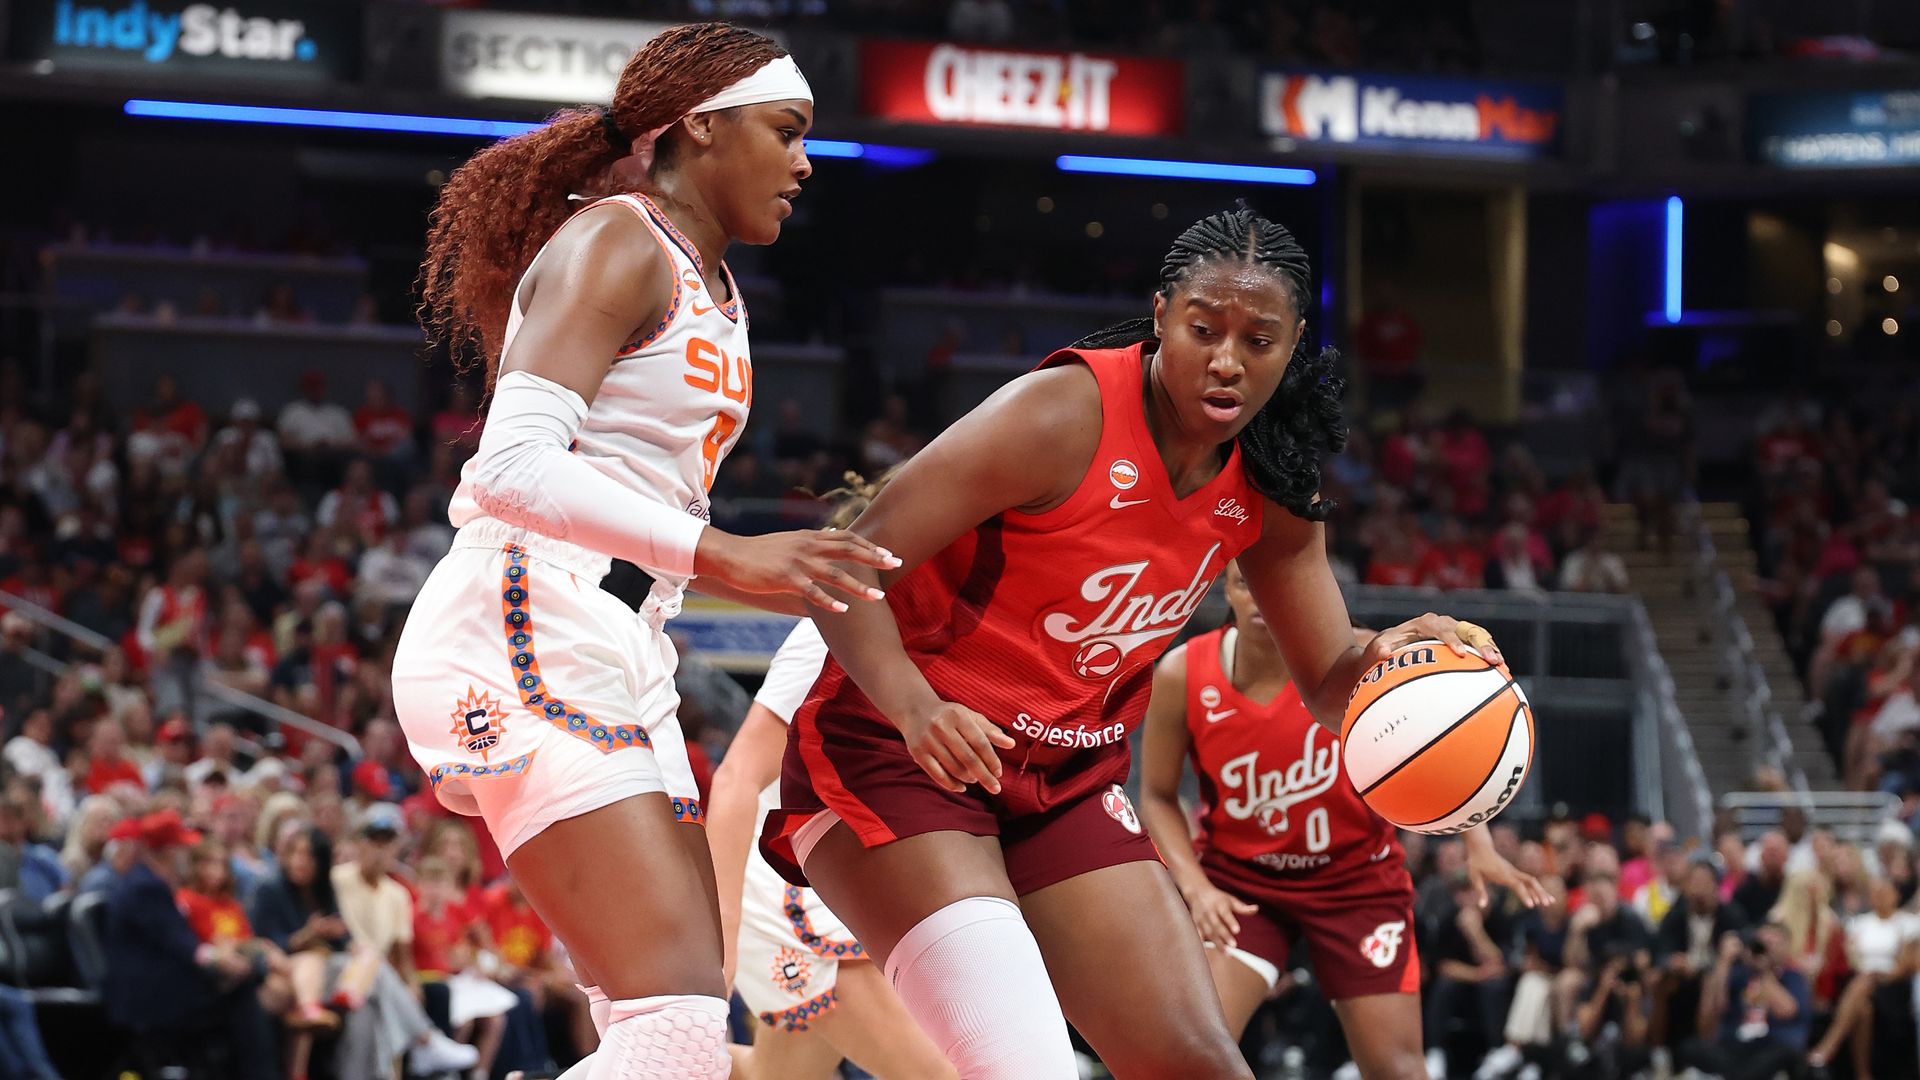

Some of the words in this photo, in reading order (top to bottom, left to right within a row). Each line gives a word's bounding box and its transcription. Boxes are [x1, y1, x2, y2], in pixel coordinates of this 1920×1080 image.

[451, 31, 631, 77] SECTIO
[1214, 498, 1249, 526] Lilly
[465, 709, 490, 736] C
[1012, 712, 1125, 748] salesforce
[1221, 721, 1340, 820] Indy
[1305, 807, 1331, 853] 0
